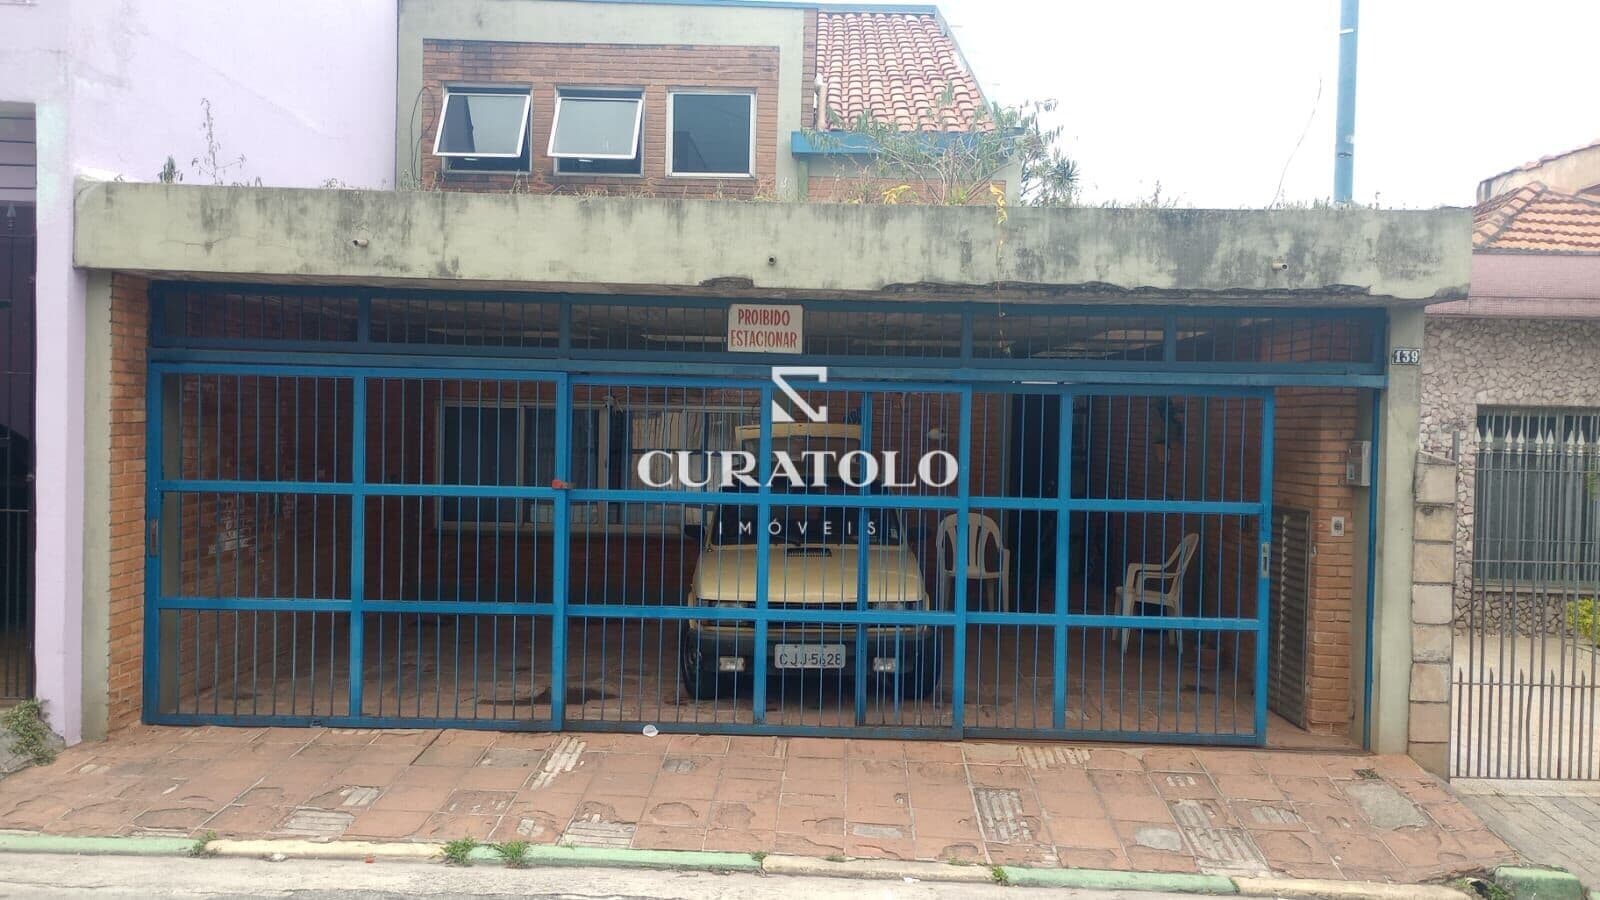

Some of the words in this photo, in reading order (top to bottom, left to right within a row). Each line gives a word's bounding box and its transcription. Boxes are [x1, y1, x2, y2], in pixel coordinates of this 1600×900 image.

[738, 309, 790, 326] PROIBIDO
[730, 330, 797, 348] ESTACIONAR
[1395, 350, 1419, 363] 139
